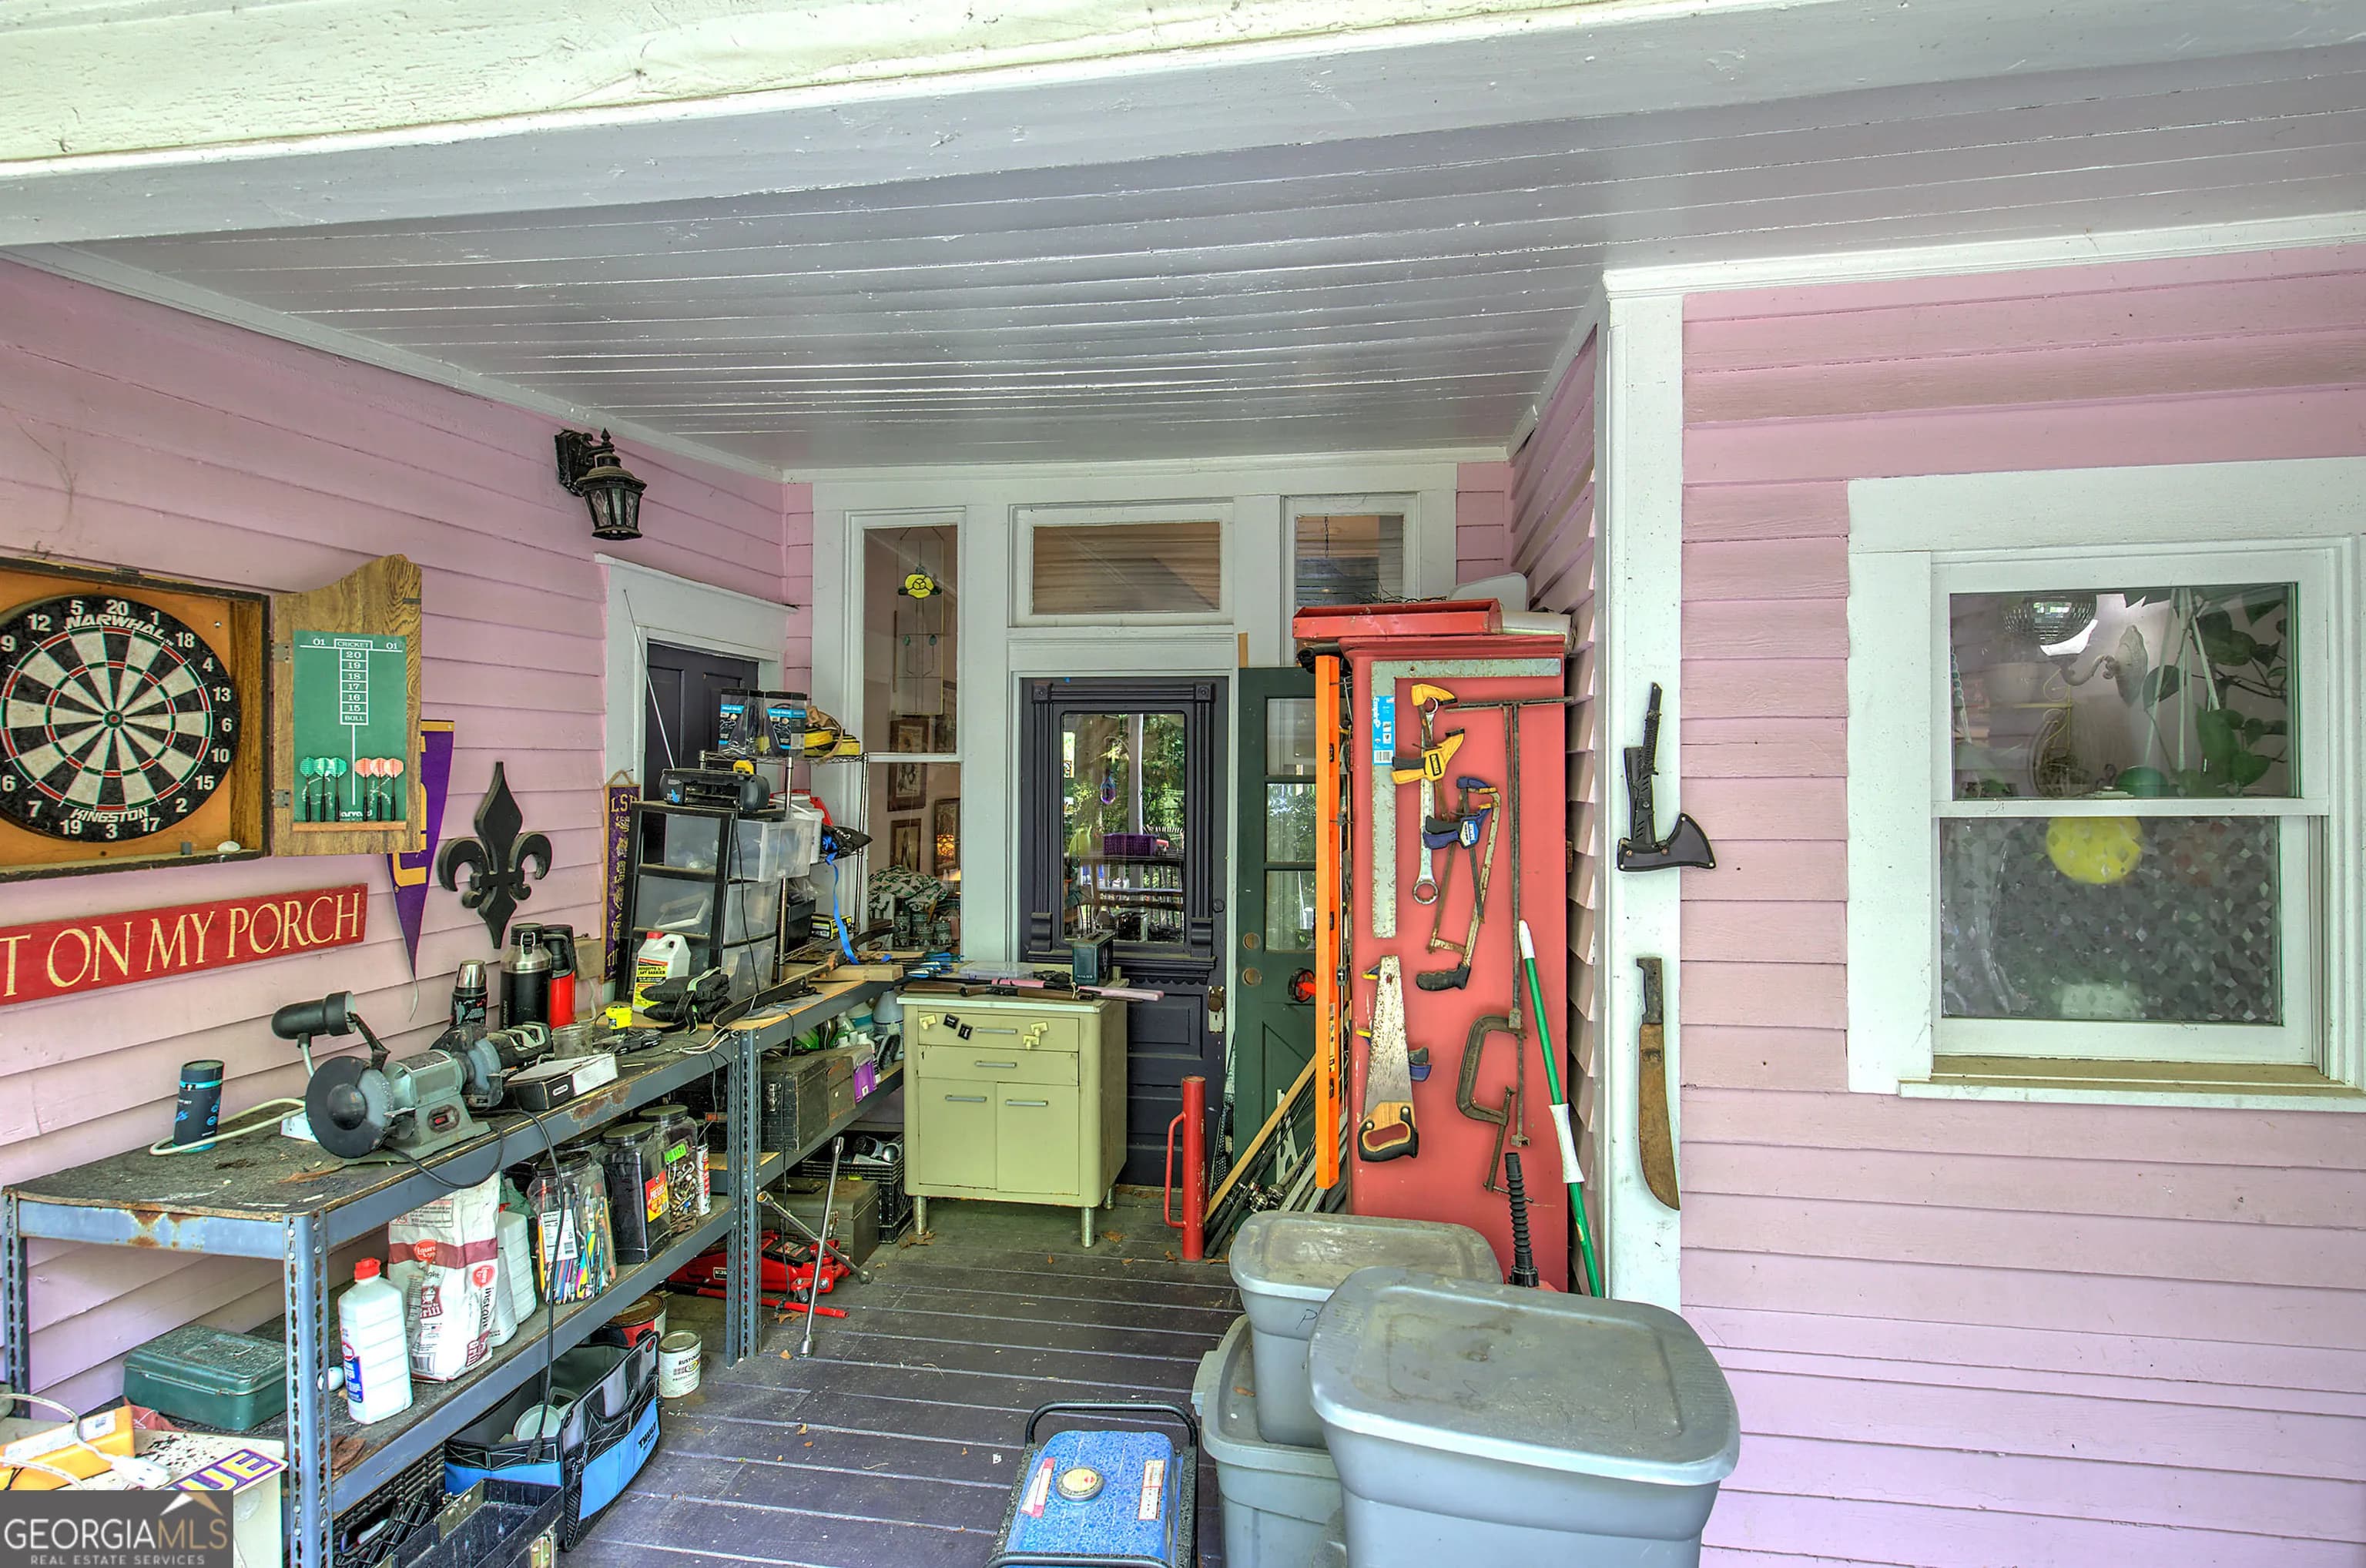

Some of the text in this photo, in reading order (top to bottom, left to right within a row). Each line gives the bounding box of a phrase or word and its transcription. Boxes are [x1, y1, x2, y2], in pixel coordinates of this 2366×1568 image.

[70, 601, 83, 615] 5
[106, 600, 129, 616] 20
[28, 614, 52, 632] 12
[151, 611, 160, 625] 1
[65, 614, 165, 640] NARWHAL
[176, 632, 195, 648] 18
[346, 651, 361, 659] 20
[202, 658, 214, 672] 4
[213, 687, 232, 702] 13
[221, 717, 233, 732] 6
[211, 748, 230, 762] 10
[0, 775, 16, 792] 6
[195, 775, 215, 790] 15
[28, 800, 42, 818] 7
[176, 799, 188, 813] 2
[70, 806, 149, 823] KINGSTON
[60, 819, 82, 836] 19
[106, 823, 119, 839] 3
[140, 817, 161, 833] 17
[47, 922, 132, 987] ON
[145, 911, 216, 973] MY
[226, 892, 360, 959] PORCH
